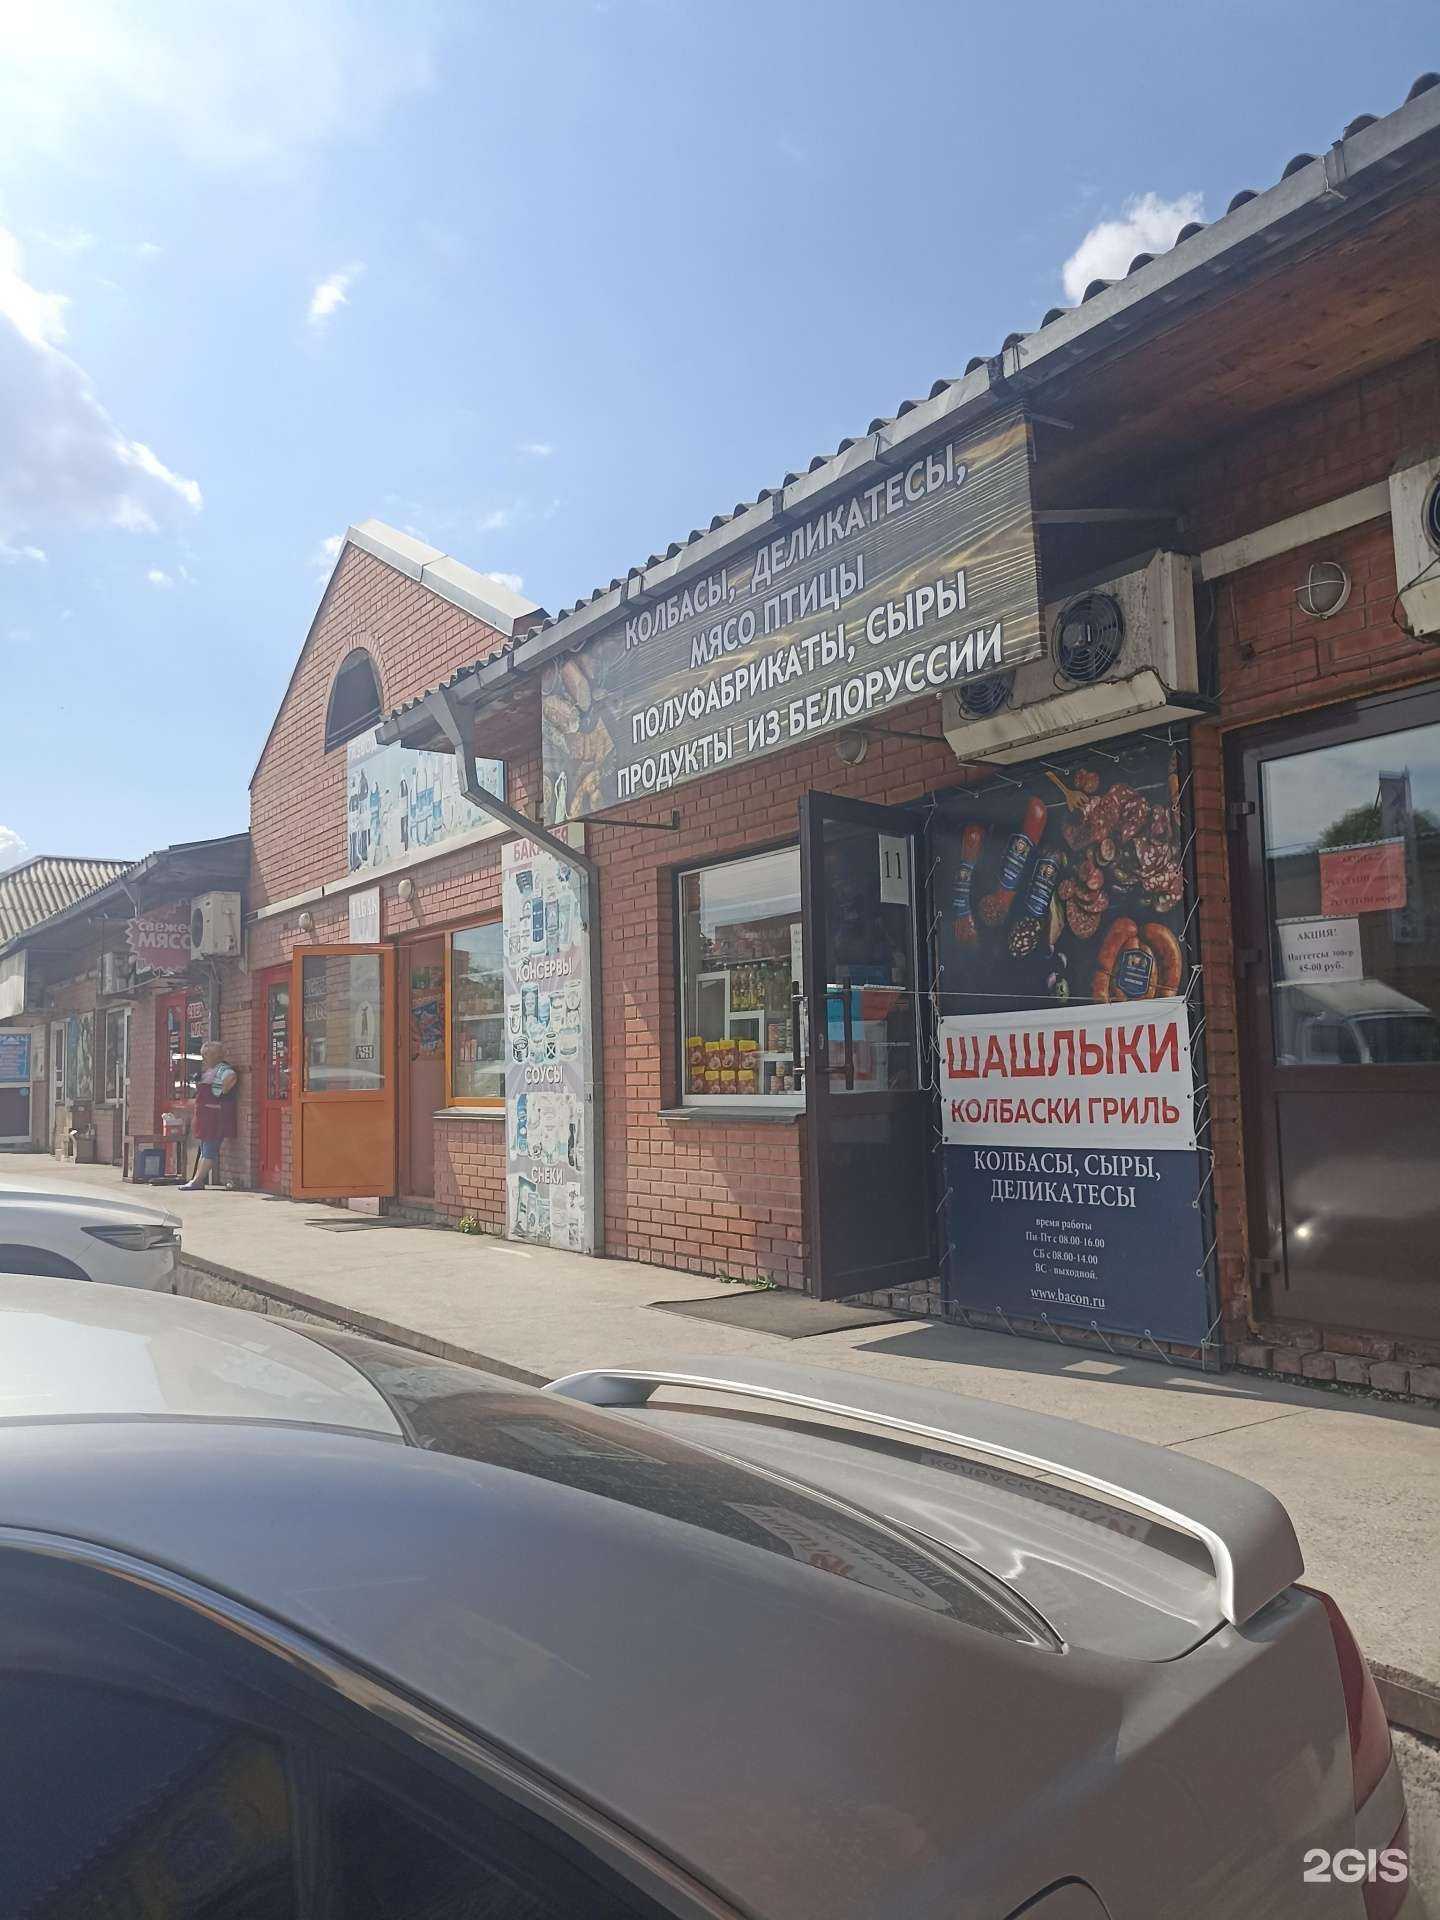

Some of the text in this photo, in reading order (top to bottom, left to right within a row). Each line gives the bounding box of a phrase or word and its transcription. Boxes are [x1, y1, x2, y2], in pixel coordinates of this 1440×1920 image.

[625, 444, 967, 650] КОЛБАСЫ, ДЕЛИКАТЕСЫ,
[689, 555, 864, 669] МЯСО ПТИЦЫ
[632, 571, 966, 744] ПОЛУФАБРИКАТЫ, СЫРЫ
[617, 623, 1002, 798] ПРОДУКТЫ ИЗ БЕЛОРУССИИ
[885, 851, 903, 879] 11
[516, 957, 573, 983] КОНСЕРВЫ
[946, 1022, 1180, 1079] ШАШЛЫКИ
[525, 1064, 563, 1085] СОУСЫ
[951, 1096, 1180, 1125] КОЛБАСКИ ГРИЛЬ
[531, 1166, 563, 1186] СНЕКИ
[974, 1150, 1161, 1181] КОЛБАСЫ, СЫРЫ,
[991, 1179, 1137, 1208] ДЕЛИКАТЕСЫ
[1036, 1218, 1092, 1231] время работы
[1033, 1248, 1045, 1258] СБ
[1035, 1263, 1047, 1273] ВС
[1030, 1288, 1105, 1308] www.bacon.ru
